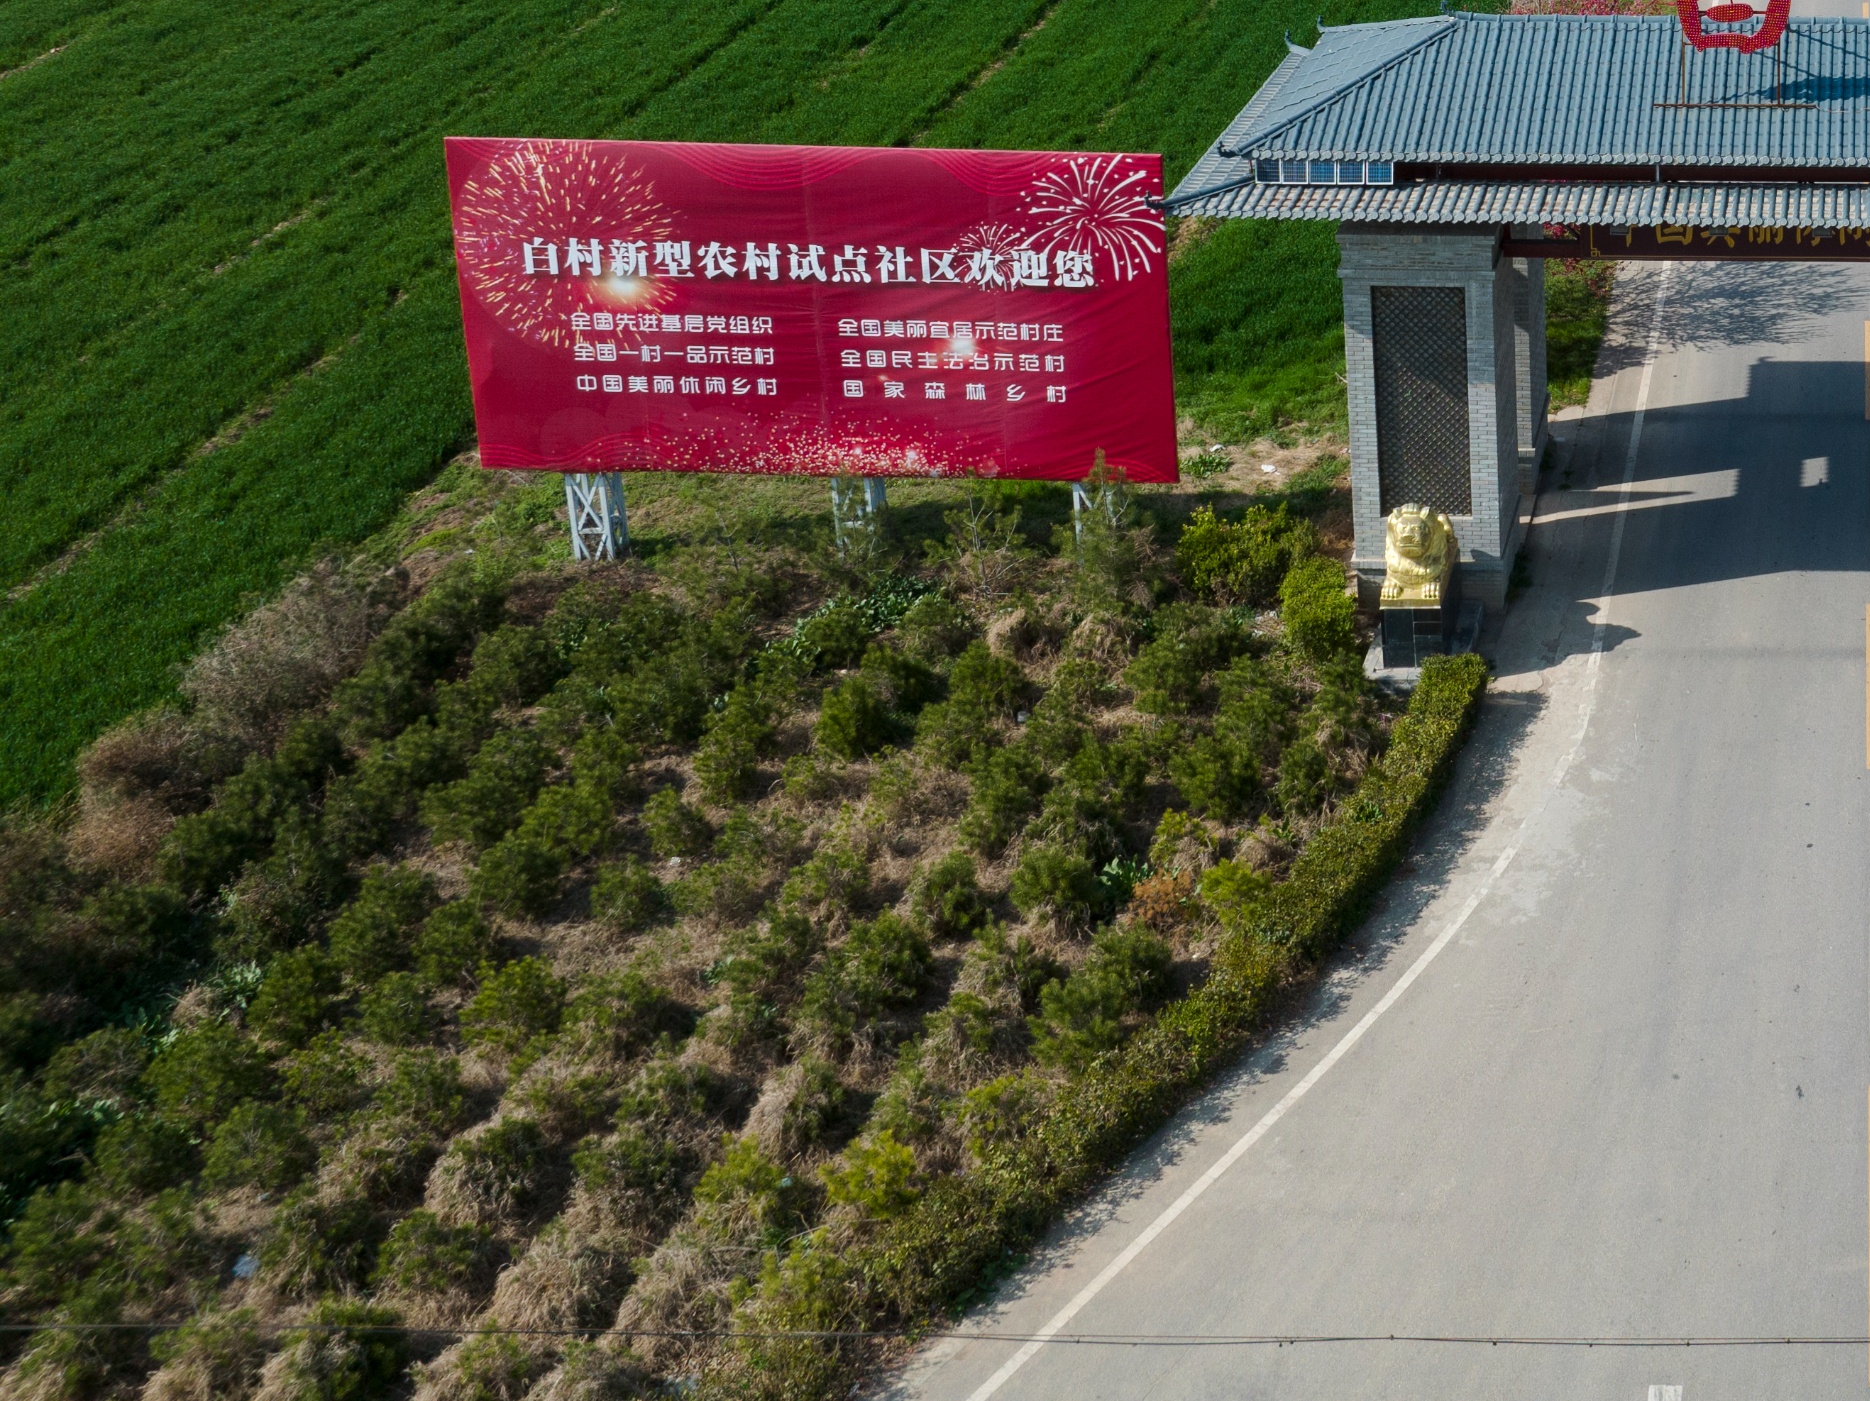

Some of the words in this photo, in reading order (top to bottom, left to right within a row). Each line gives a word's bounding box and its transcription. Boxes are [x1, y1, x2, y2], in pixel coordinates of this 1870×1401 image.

[522, 236, 1095, 288] 白村新型农村试点社区欢迎您
[570, 312, 773, 335] 全国先进基层党组织
[838, 318, 1064, 342] 全国美丽宜居示范村庄
[573, 343, 775, 366] 全国一村一品示范村
[840, 349, 1065, 373] 全国民主法治示范村
[576, 374, 778, 396] 中国美丽休闲乡村
[843, 379, 1067, 403] 国家森林乡村
